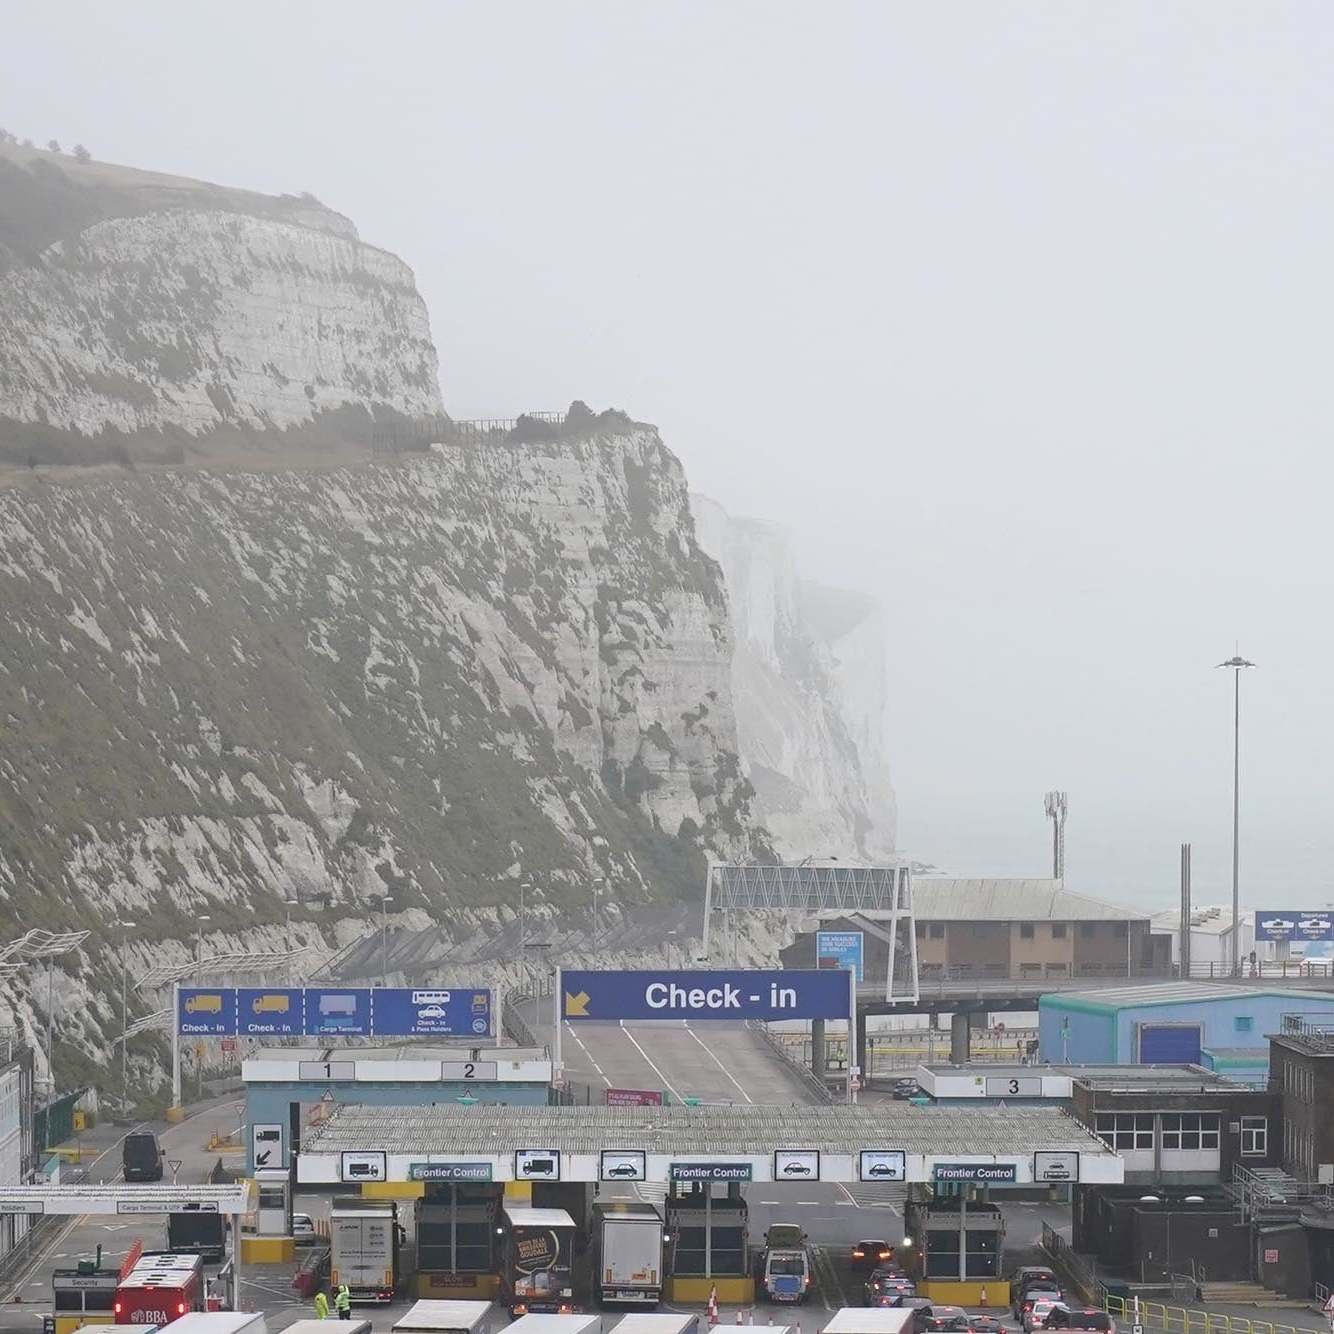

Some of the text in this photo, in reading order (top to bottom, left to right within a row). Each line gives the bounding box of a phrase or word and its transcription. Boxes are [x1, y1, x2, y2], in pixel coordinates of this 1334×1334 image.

[646, 983, 741, 1008] Check
[771, 983, 797, 1008] in
[182, 1024, 211, 1032] Check
[217, 1024, 225, 1032] In
[248, 1024, 278, 1032] Check
[283, 1024, 291, 1032] In
[320, 1026, 340, 1034] Cargo
[323, 1064, 331, 1078] 1
[464, 1064, 475, 1078] 2
[1009, 1079, 1019, 1094] 3
[414, 1167, 489, 1178] Frontier Control
[673, 1167, 749, 1178] Frontier Control
[937, 1168, 1013, 1179] Frontier Control
[1, 1204, 25, 1212] holders
[122, 1204, 137, 1212] Cargo
[146, 1311, 168, 1323] BBA
